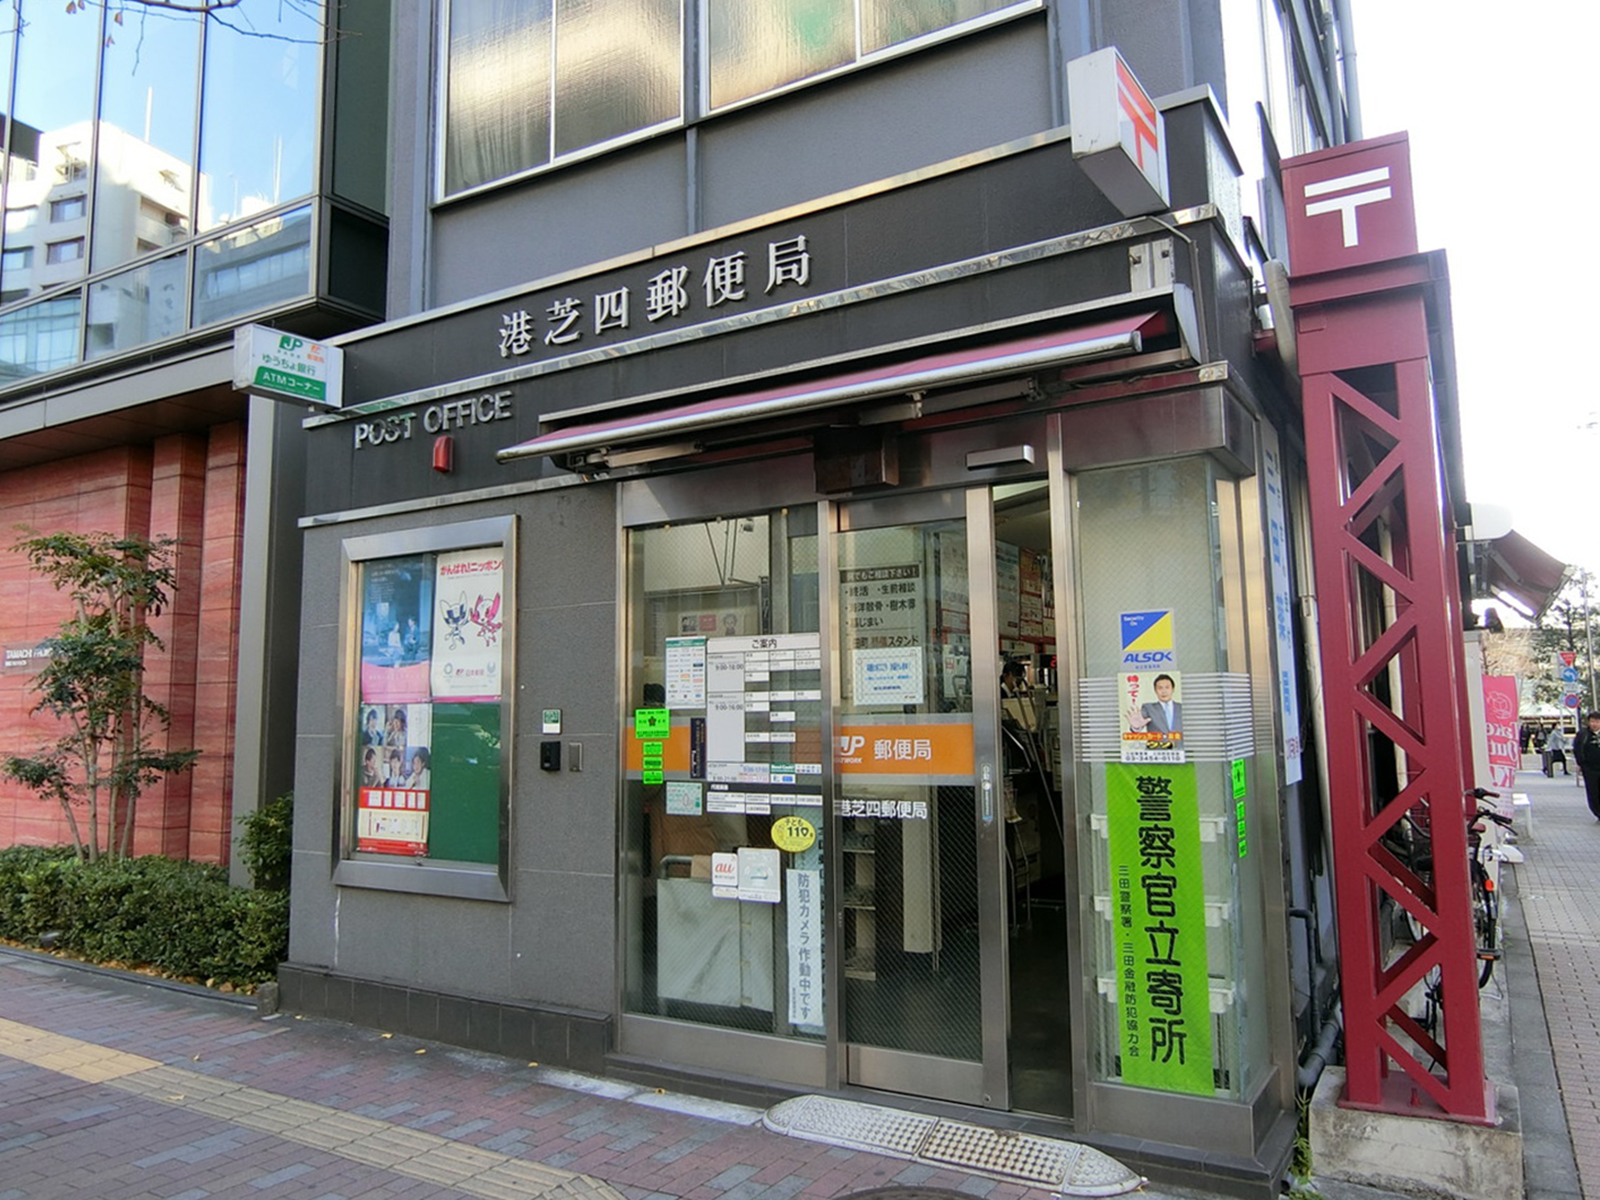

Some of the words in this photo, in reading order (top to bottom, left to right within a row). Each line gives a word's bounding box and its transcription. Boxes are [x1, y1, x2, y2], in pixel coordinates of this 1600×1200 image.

[499, 235, 811, 357] 港芝四郵便局
[262, 353, 316, 377] ゆうちょ銀行
[263, 372, 320, 391] ATMコーナー
[355, 412, 416, 449] POST
[423, 390, 512, 434] OFFICE
[751, 639, 777, 649] ご案内
[1123, 651, 1173, 664] ALSOK
[873, 739, 932, 761] 郵便局
[715, 862, 734, 874] au
[1135, 776, 1188, 1065] 警察官立寄所
[798, 873, 811, 1020] 防犯カメラ作動中です
